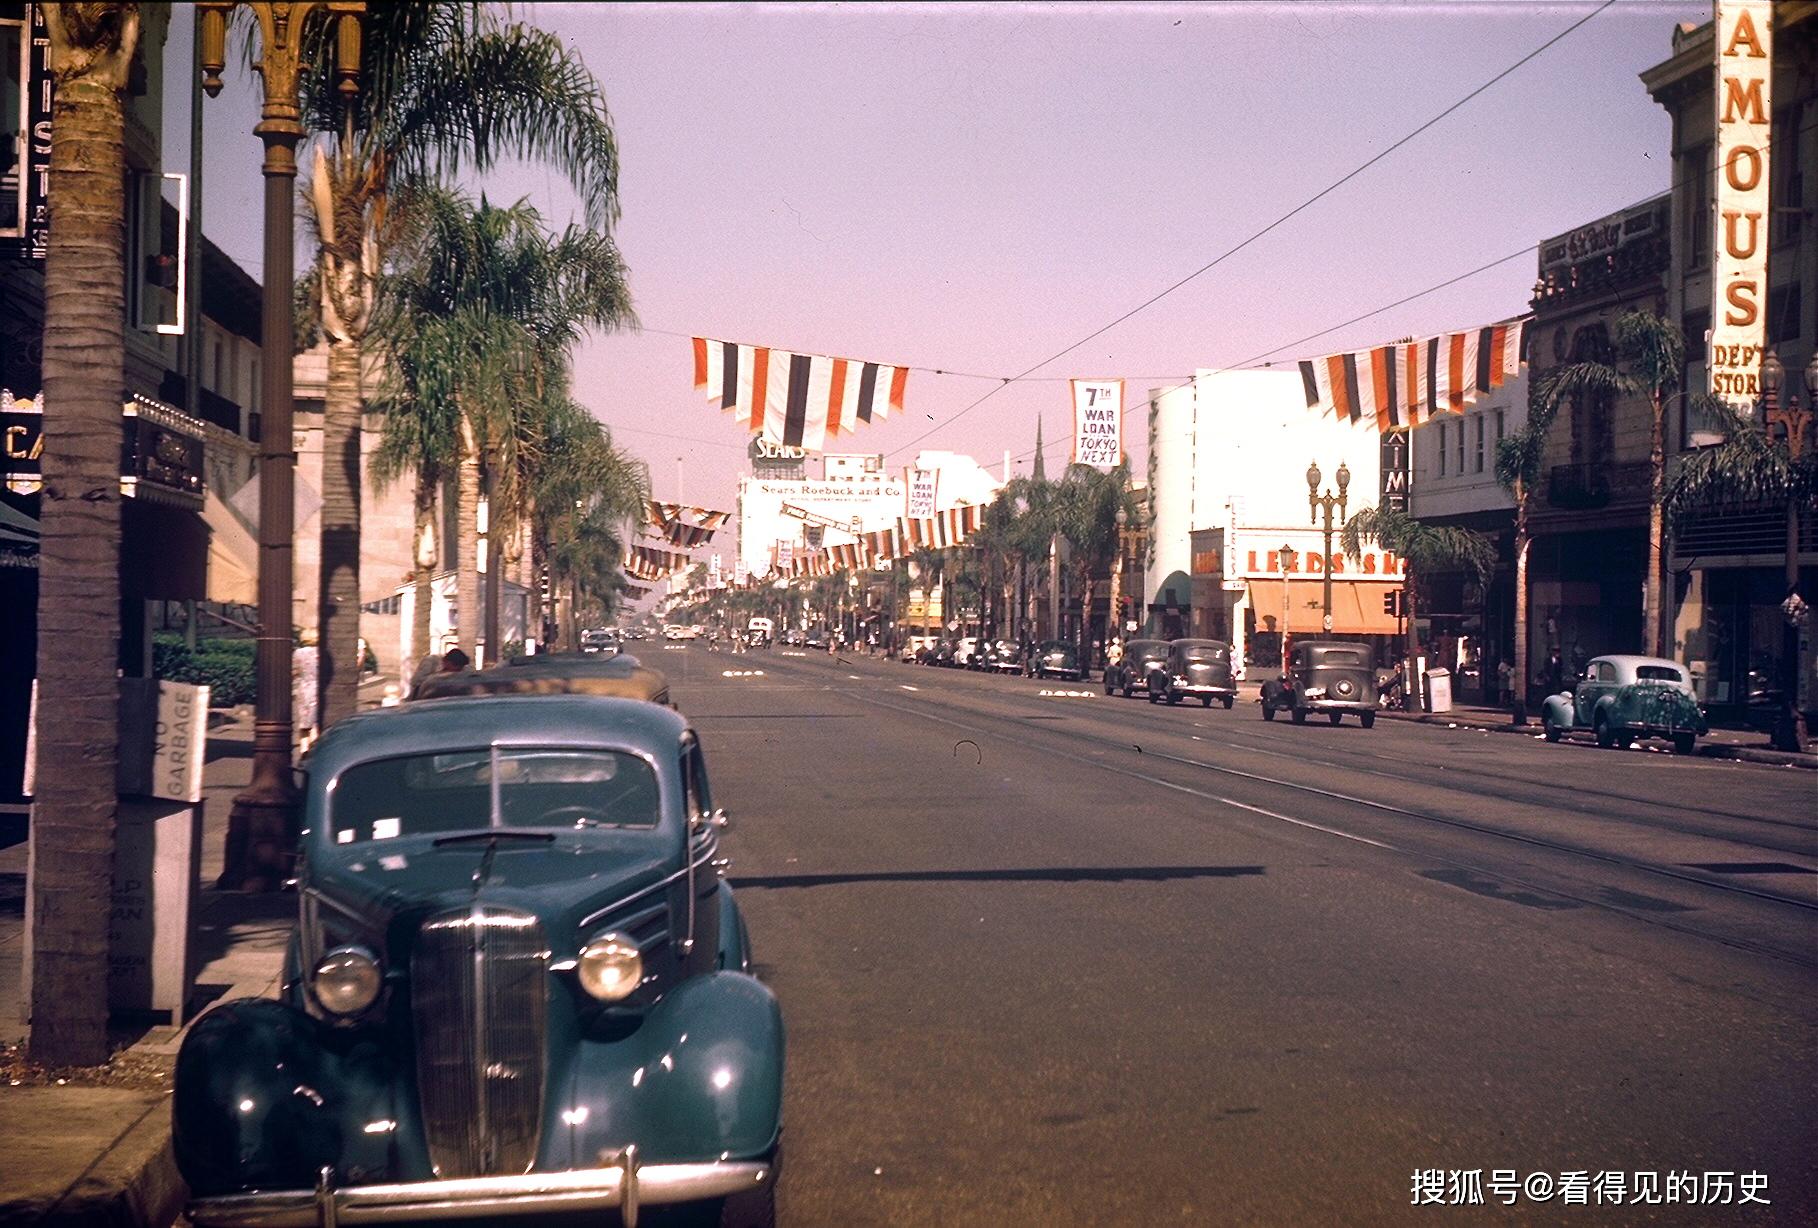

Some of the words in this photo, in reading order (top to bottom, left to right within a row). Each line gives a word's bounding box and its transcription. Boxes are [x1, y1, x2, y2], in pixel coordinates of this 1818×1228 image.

[1713, 373, 1764, 395] STOR
[1085, 409, 1114, 421] WAR
[1083, 423, 1116, 435] LOAN
[1081, 437, 1117, 451] TOKYO
[1081, 450, 1117, 463] NEXT
[761, 485, 796, 494] Sears
[801, 486, 854, 495] Roebuck
[859, 486, 880, 496] and
[153, 721, 168, 756] NO
[167, 692, 192, 796] GARBAGE
